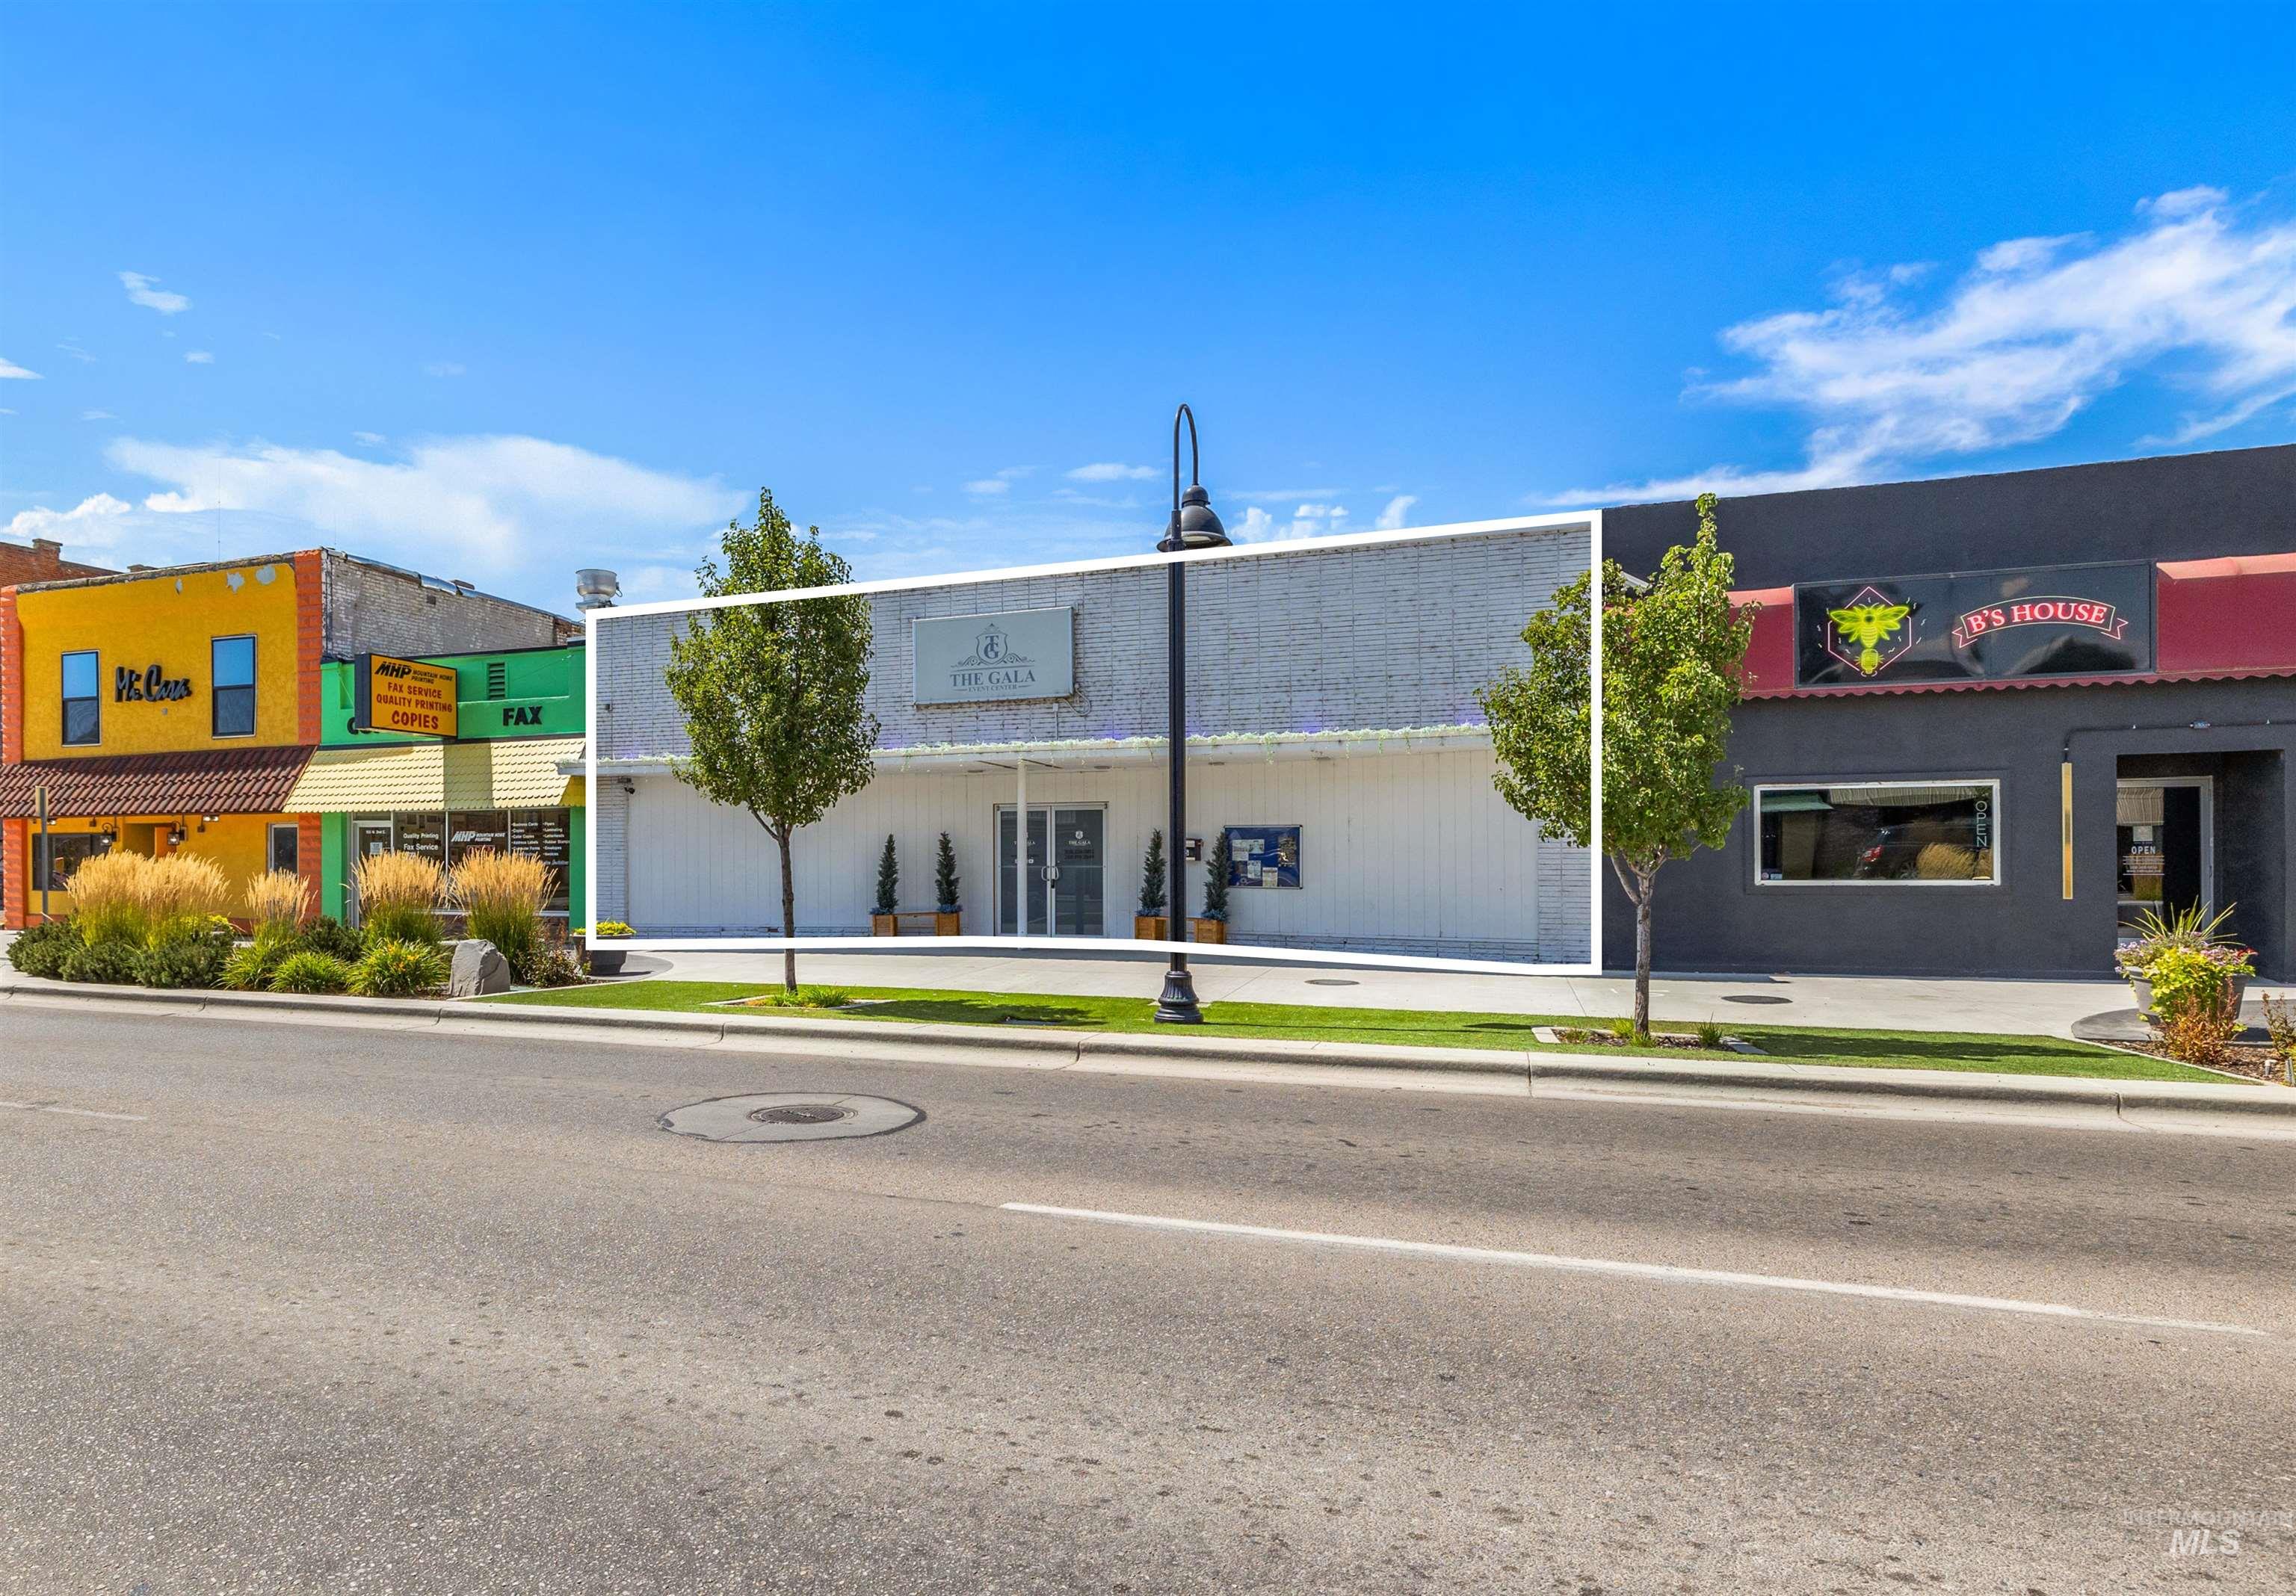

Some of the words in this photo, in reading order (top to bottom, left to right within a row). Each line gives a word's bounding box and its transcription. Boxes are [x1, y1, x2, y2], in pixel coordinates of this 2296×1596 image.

[2010, 601, 2108, 625] HOUSE
[374, 661, 412, 679] MHP
[412, 669, 438, 679] MOUNTAIN
[411, 675, 435, 684] PRINTING
[950, 672, 984, 687] THE
[988, 669, 1036, 684] GALA
[144, 664, 193, 702] Casa
[388, 681, 404, 693] FAX
[407, 685, 442, 699] SERVICE
[376, 693, 412, 708] QUALITY
[415, 699, 452, 713] PRINTING
[391, 710, 439, 730] COPIES
[502, 705, 543, 726] FAX
[1975, 800, 1988, 847] OPEN
[451, 831, 476, 842] MHP
[2131, 846, 2156, 855] OPEN
